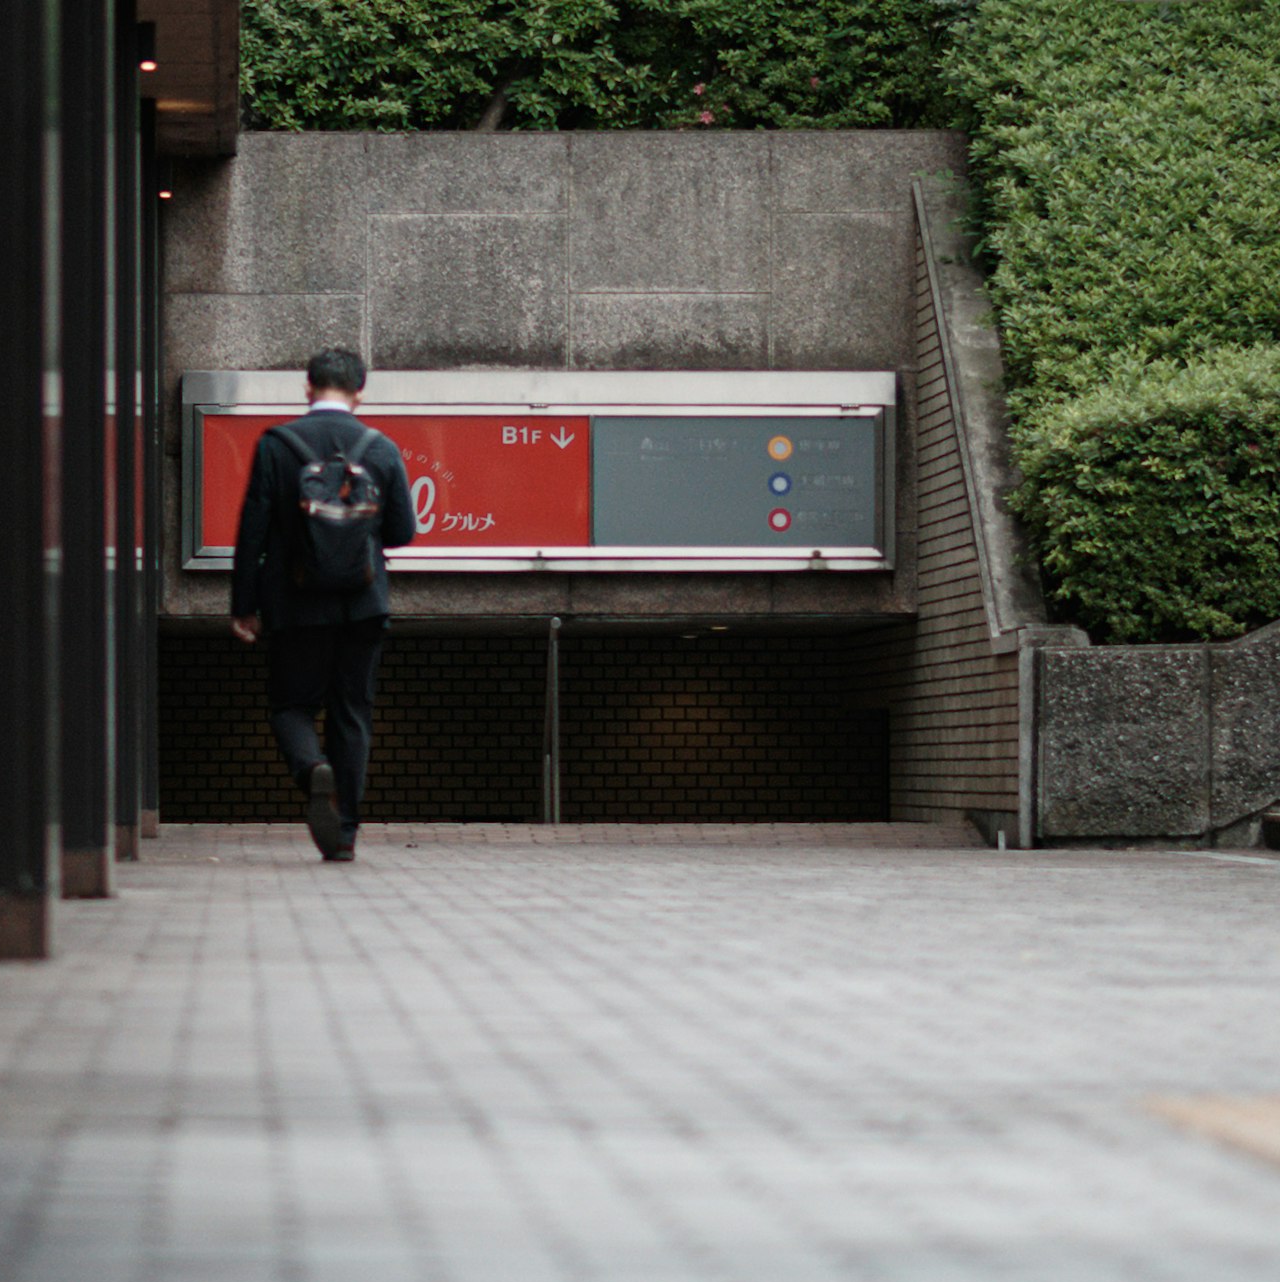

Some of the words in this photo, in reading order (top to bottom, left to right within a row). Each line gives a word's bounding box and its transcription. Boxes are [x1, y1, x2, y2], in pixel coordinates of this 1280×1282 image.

[502, 426, 542, 444] B1F
[441, 513, 496, 532] グルメ
